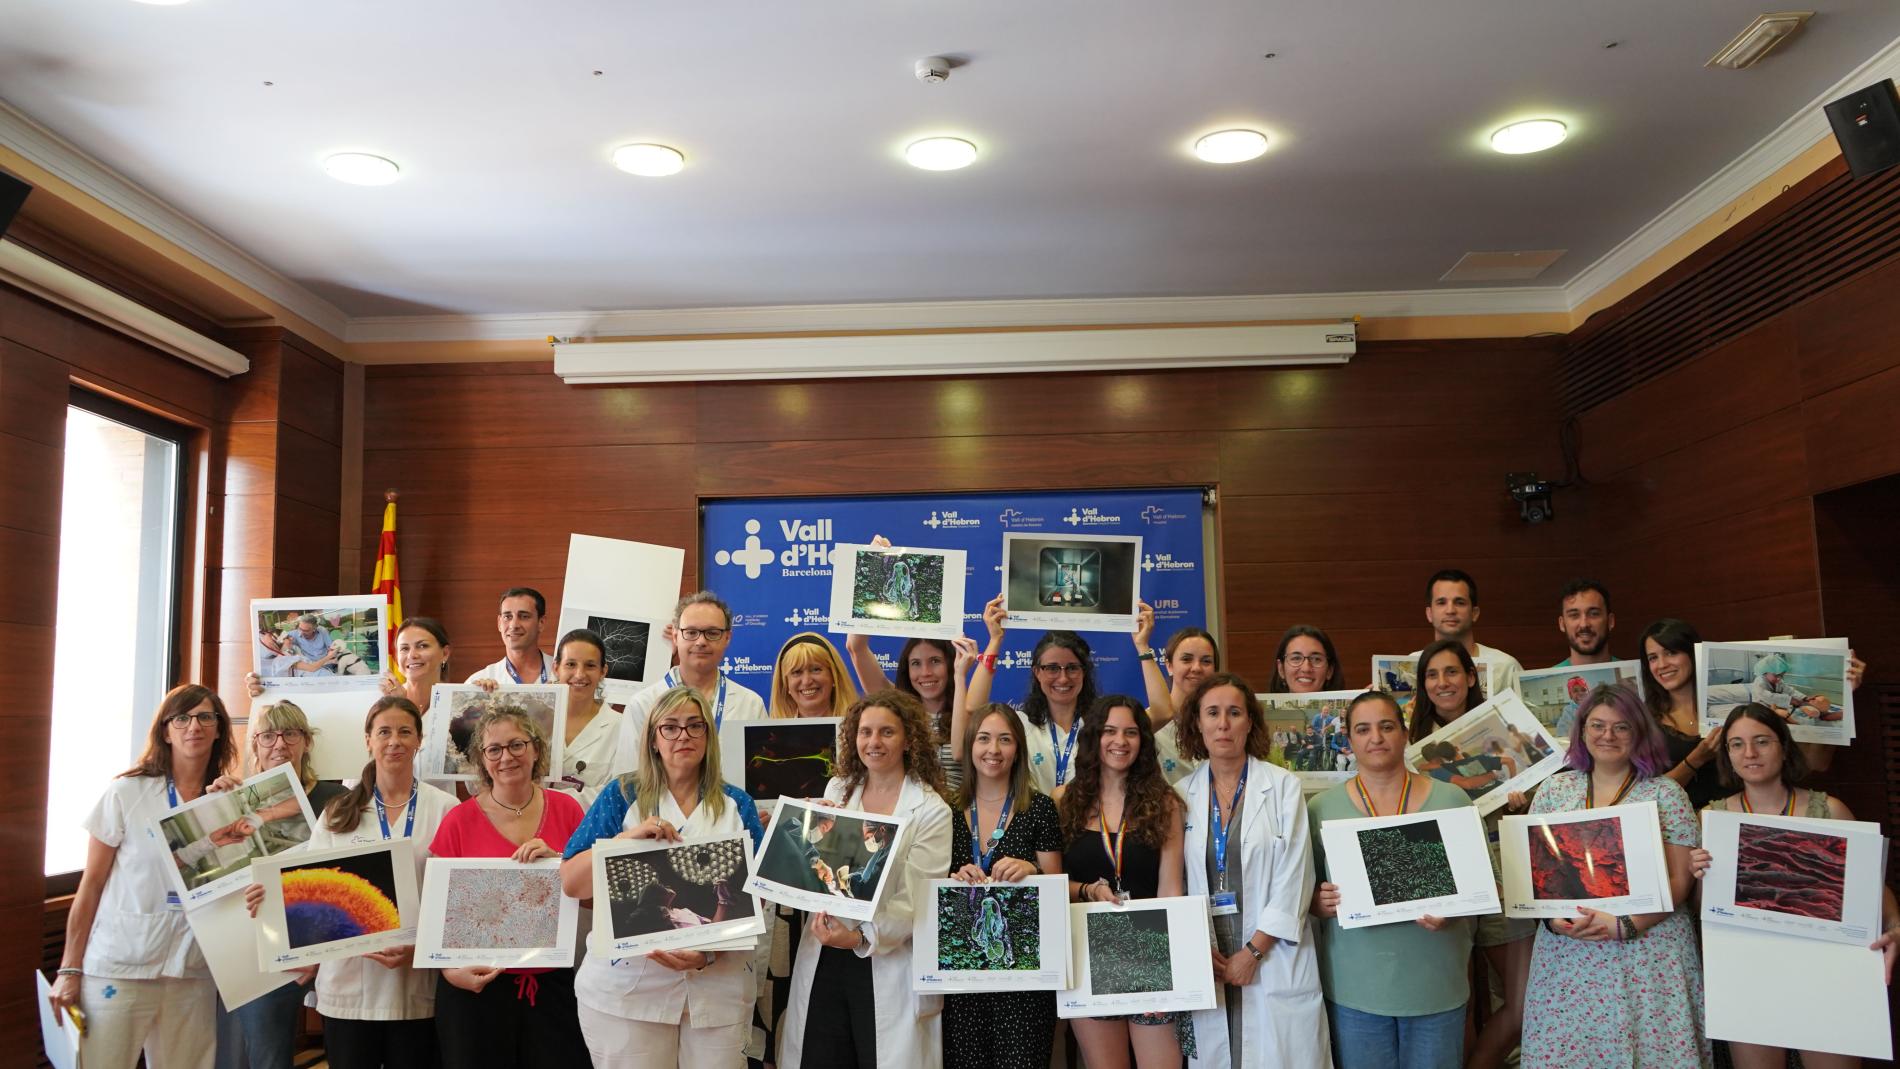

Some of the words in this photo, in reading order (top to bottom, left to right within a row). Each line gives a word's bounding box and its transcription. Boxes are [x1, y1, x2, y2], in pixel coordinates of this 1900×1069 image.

[942, 511, 958, 519] Vall
[779, 519, 832, 541] Vall
[782, 568, 832, 576] Barcelona
